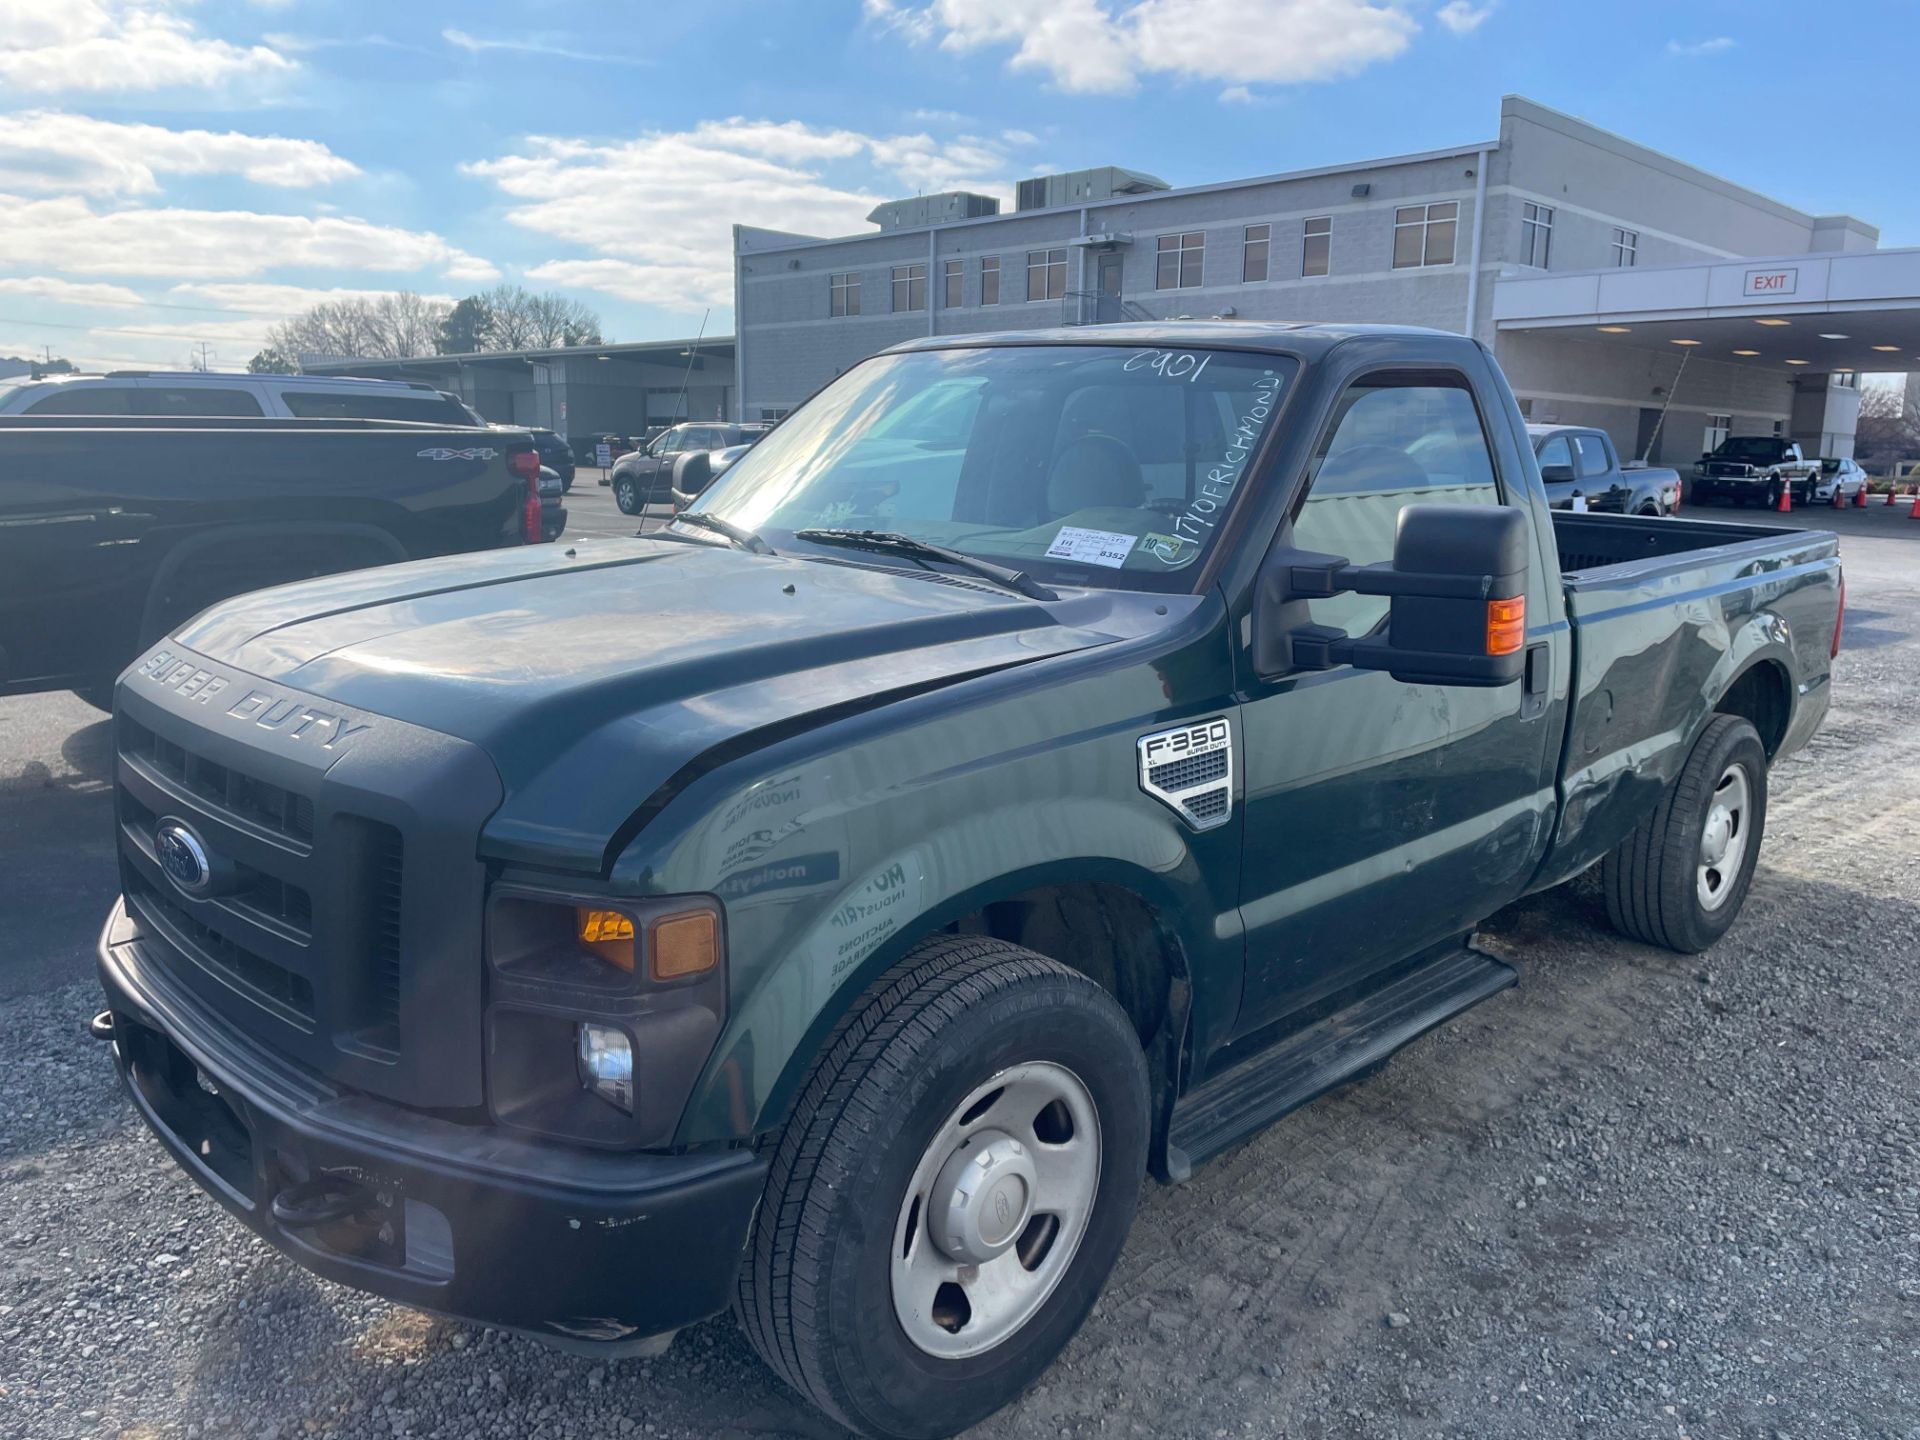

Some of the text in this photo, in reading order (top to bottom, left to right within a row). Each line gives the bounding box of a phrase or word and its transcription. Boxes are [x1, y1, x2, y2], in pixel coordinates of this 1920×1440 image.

[1755, 275, 1786, 289] EXIT
[1144, 537, 1158, 550] 10
[1099, 549, 1126, 561] 8352
[138, 650, 372, 750] SUPER DUTY
